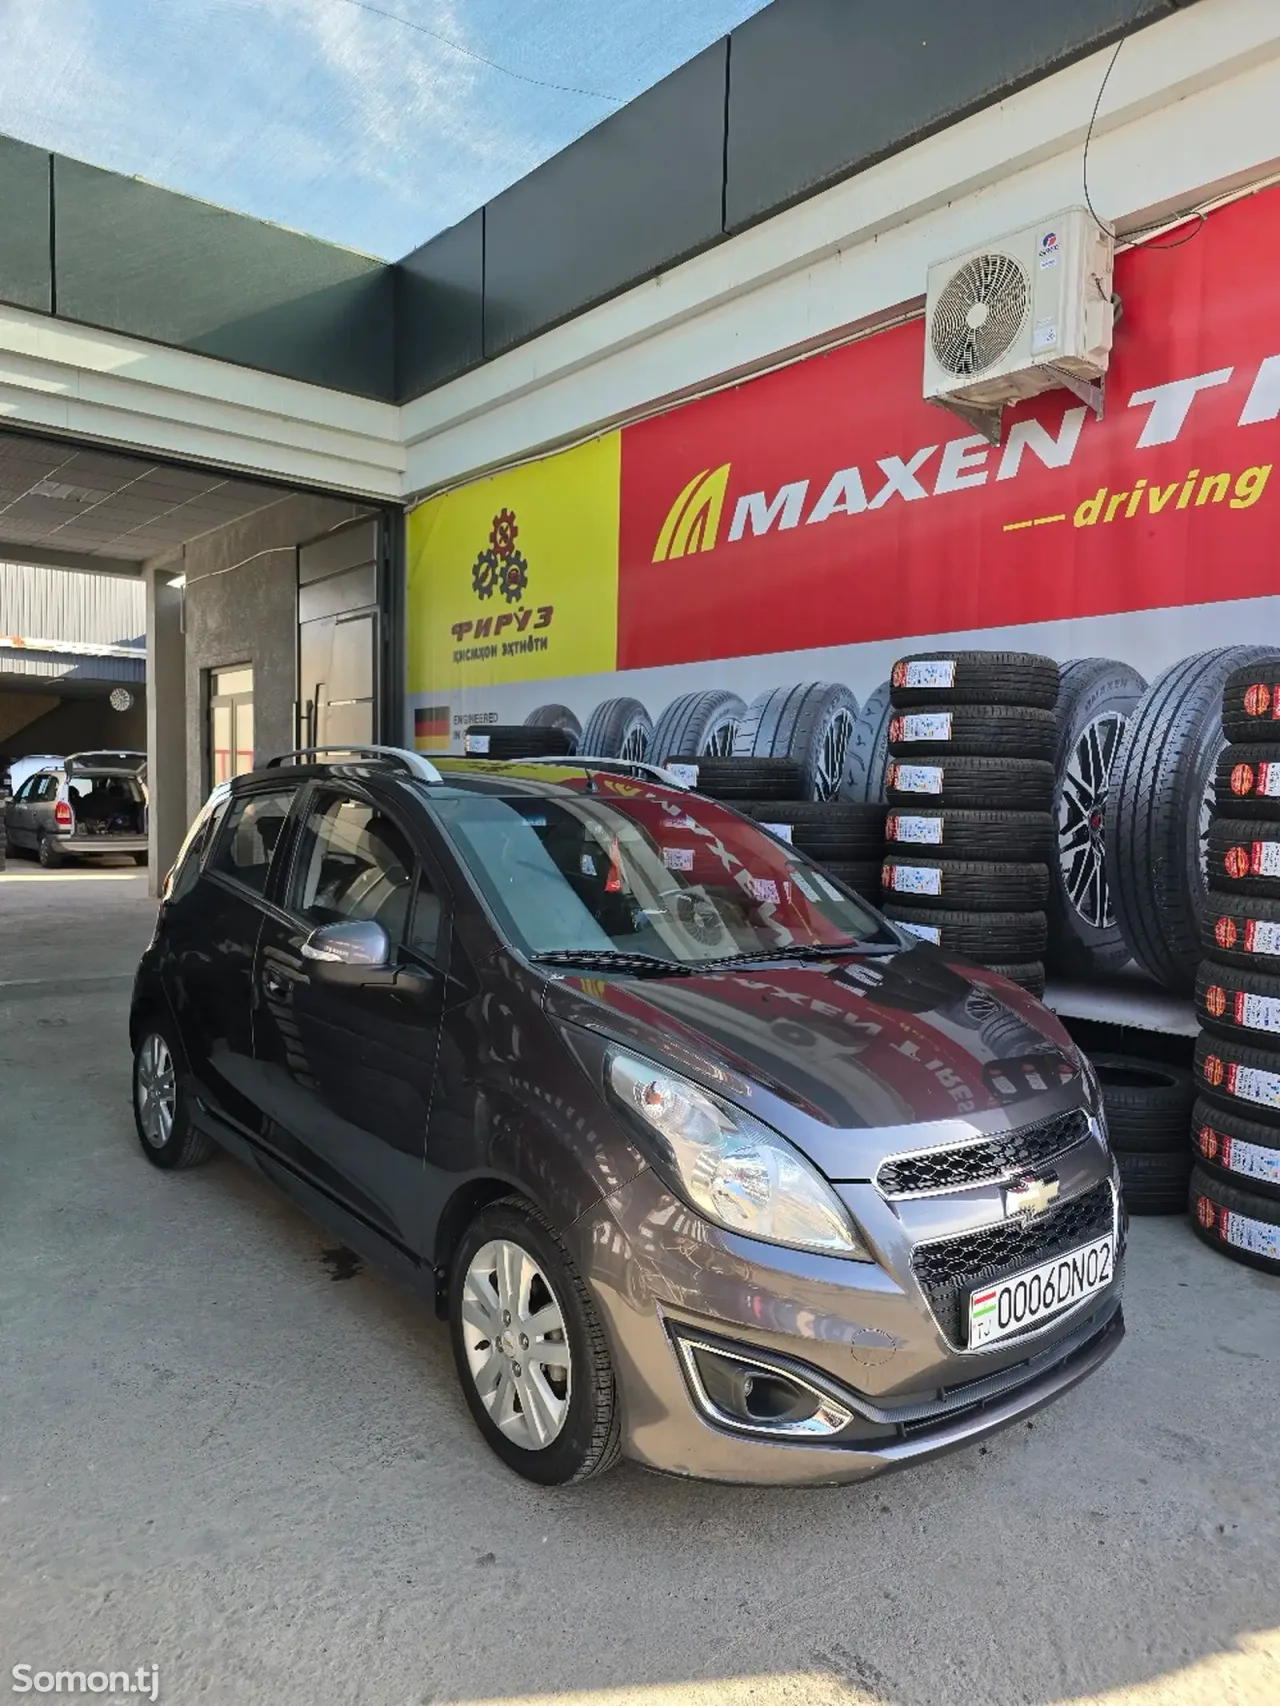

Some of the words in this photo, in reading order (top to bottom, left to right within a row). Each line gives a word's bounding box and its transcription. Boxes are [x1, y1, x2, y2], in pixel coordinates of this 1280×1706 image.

[728, 406, 1088, 543] MAXEN
[1073, 464, 1273, 528] driving
[453, 712, 499, 725] ENGINEERED
[998, 1242, 1111, 1329] 0006DN02
[976, 1319, 992, 1340] TJ
